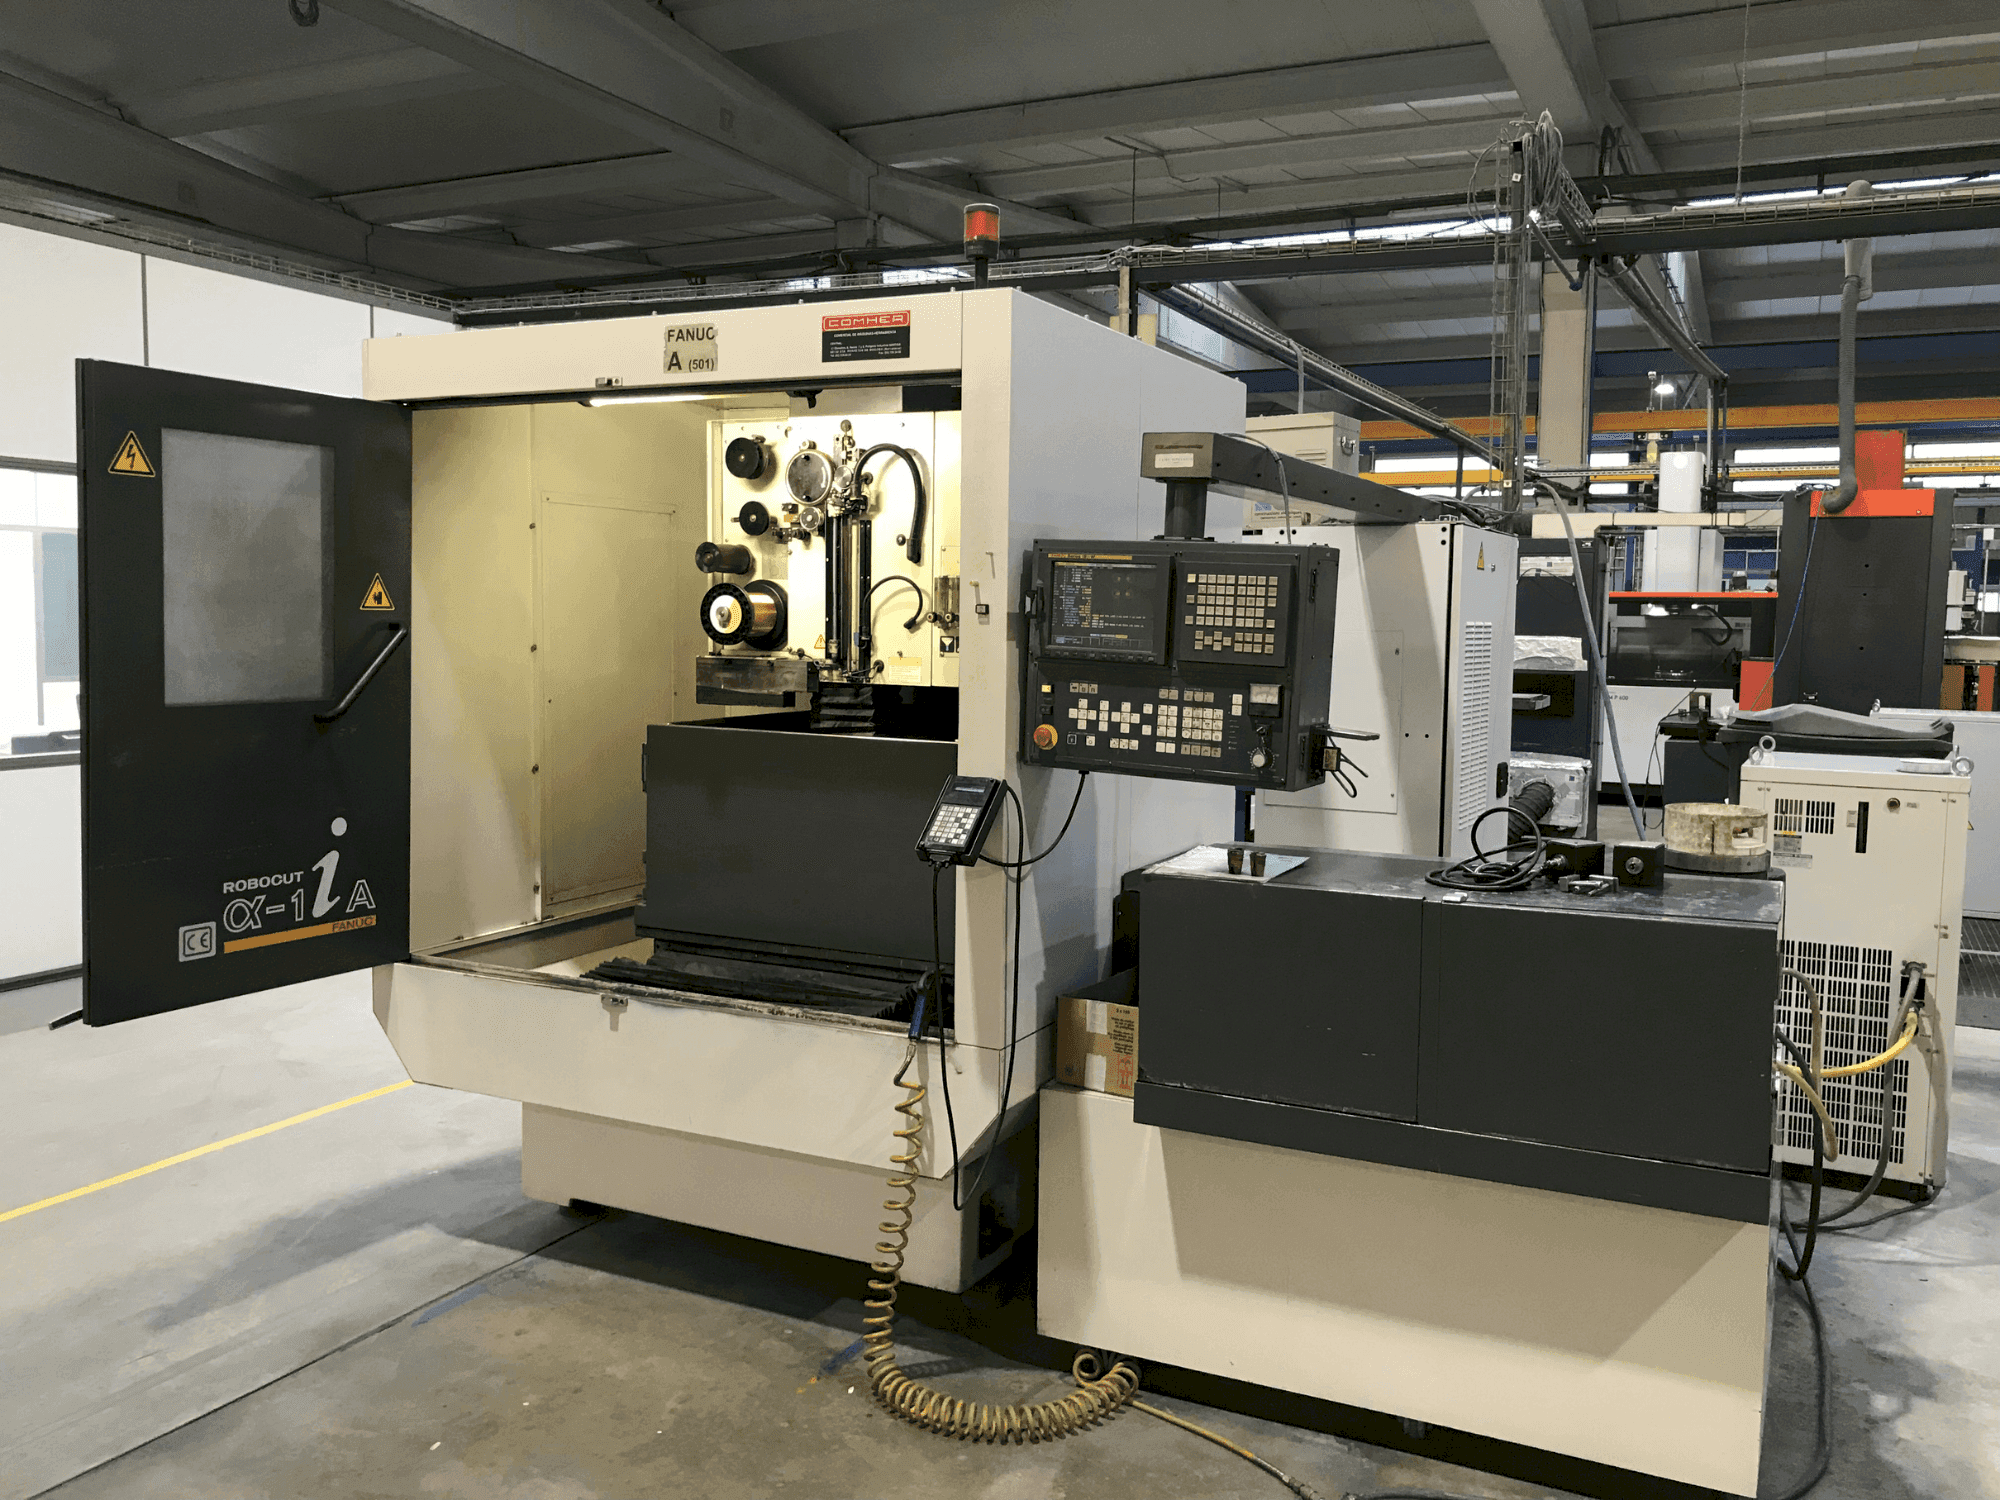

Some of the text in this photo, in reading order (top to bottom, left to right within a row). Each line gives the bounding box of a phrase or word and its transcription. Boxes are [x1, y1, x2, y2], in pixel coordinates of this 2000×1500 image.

[828, 314, 903, 327] COMHER
[667, 326, 716, 343] FANUC
[667, 351, 715, 373] A (501)
[222, 870, 304, 894] ROBOCUT
[331, 914, 376, 934] FANUC
